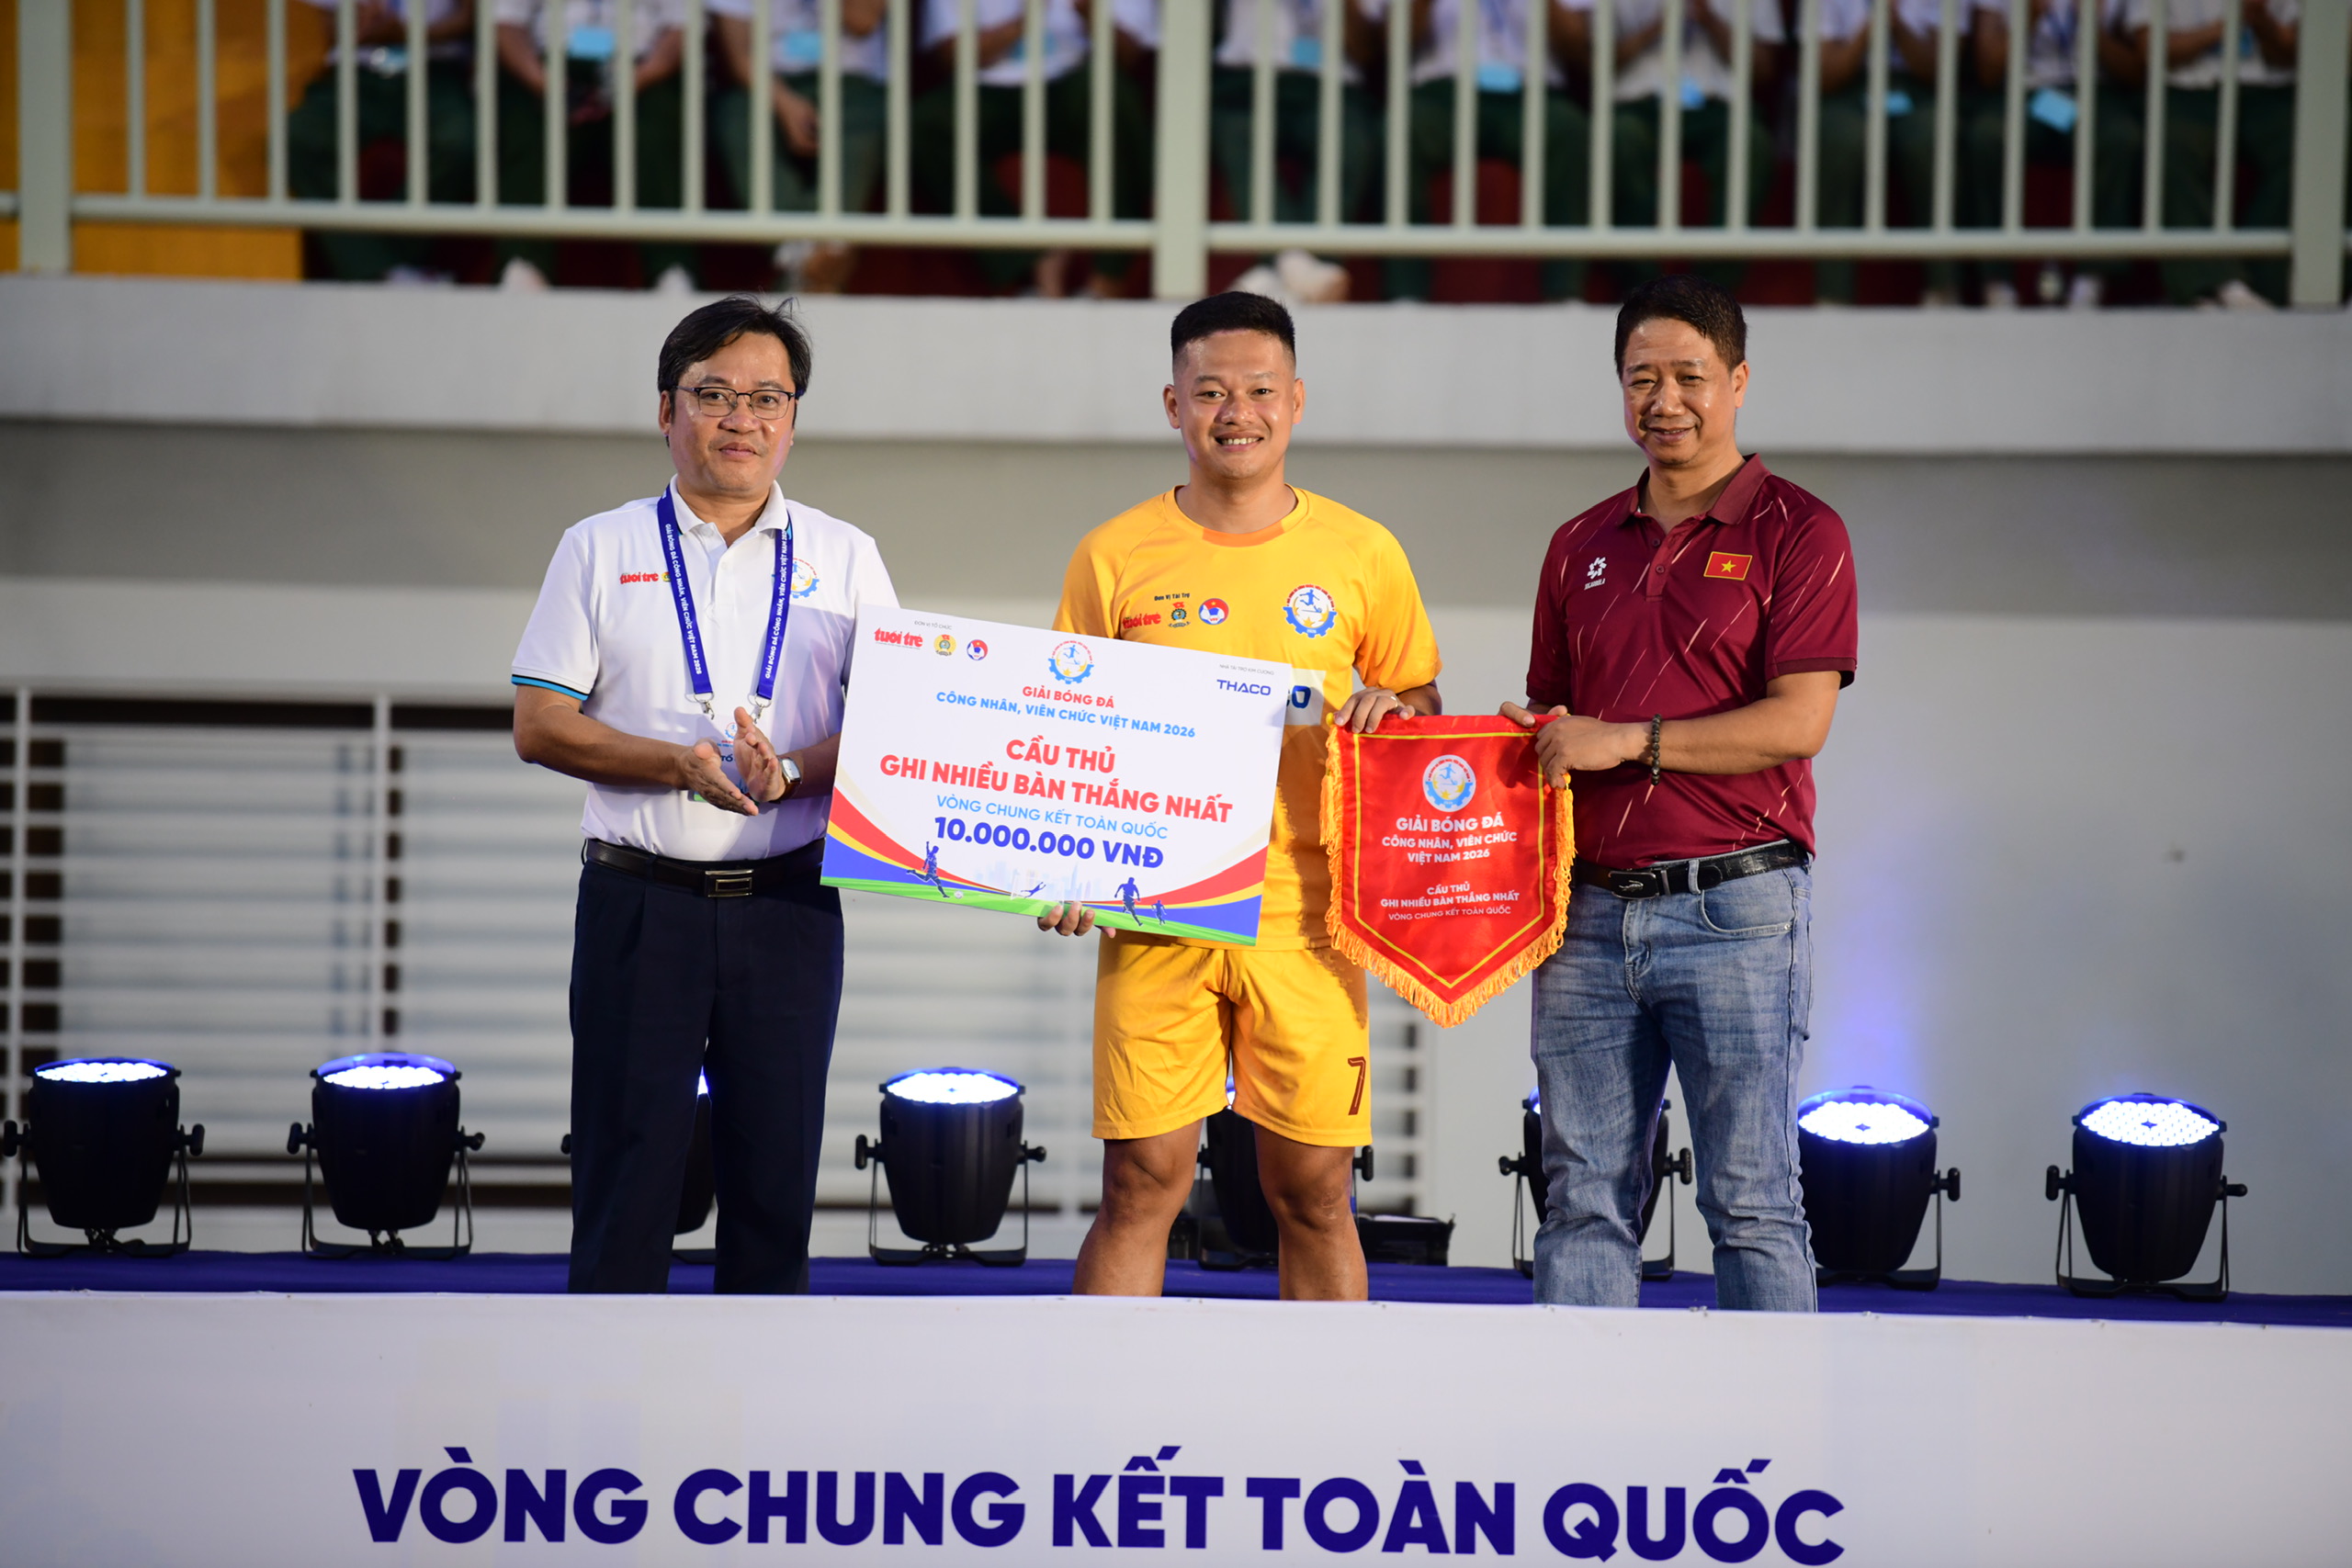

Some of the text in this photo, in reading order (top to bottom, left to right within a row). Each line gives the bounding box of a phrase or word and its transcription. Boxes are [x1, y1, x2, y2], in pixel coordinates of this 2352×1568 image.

[667, 535, 676, 551] BÓNG
[673, 559, 683, 578] CÔNG
[681, 597, 689, 612] VIÊN
[684, 612, 693, 629] CHỨC
[768, 646, 777, 665] BÓNG
[773, 616, 782, 636] CÔNG
[778, 582, 786, 596] VIÊN
[687, 629, 695, 643] VIỆT
[690, 644, 699, 659] NAM
[694, 660, 703, 674] 2026
[1023, 685, 1114, 708] GIẢI BÓNG ĐÁ
[1216, 679, 1271, 696] THACO
[936, 691, 1196, 738] CÔNG NHÂN, VIÊN CHỨC VIỆT NAM 2026
[1006, 735, 1115, 773] CẦU THỦ
[879, 754, 1233, 823] GHI NHIỀU BÀN THẮNG NHẤT
[937, 794, 1168, 839] VÒNG CHUNG KẾT TOÀN QUỐC
[1396, 812, 1504, 832] GIẢI BÓNG ĐÁ
[934, 817, 1164, 868] 10.000.000 VNĐ
[1382, 830, 1518, 850] CÔNG NHÂN, VIÊN CHỨC
[1408, 849, 1490, 865] VIỆT NAM 2026
[1451, 881, 1471, 893] THỦ
[1380, 898, 1399, 908] GHI
[1433, 895, 1453, 906] BÀN
[1455, 891, 1491, 903] THẮNG
[1493, 889, 1520, 902] NHẤT
[1388, 904, 1511, 920] VÒNG CHUNG KẾT TOÀN QUỐC
[1347, 1056, 1366, 1115] 7
[353, 1446, 1846, 1566] VÒNG CHUNG KẾT TOÀN QUỐC
